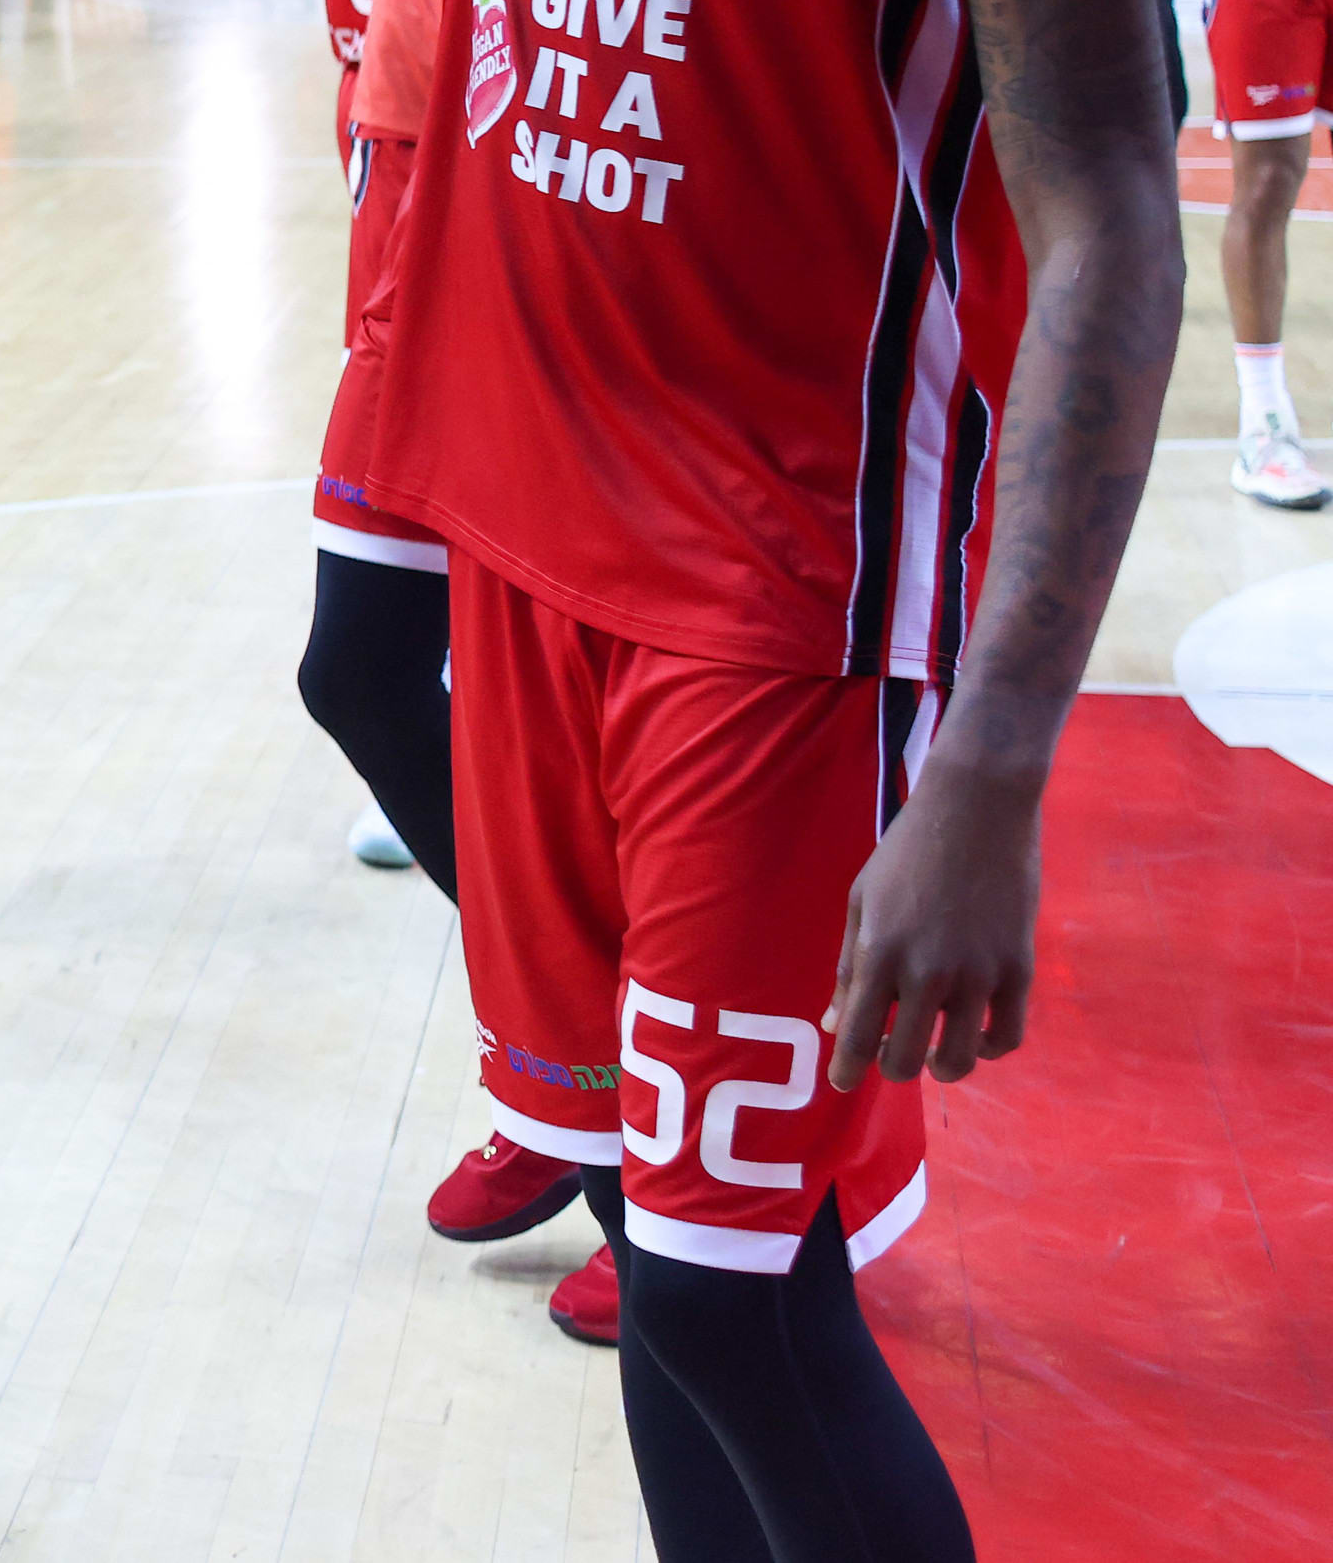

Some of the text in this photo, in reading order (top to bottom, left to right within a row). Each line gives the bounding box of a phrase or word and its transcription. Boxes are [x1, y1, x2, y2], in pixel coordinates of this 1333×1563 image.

[524, 46, 663, 141] IT A
[511, 120, 685, 224] SHOT
[621, 977, 820, 1189] 52
